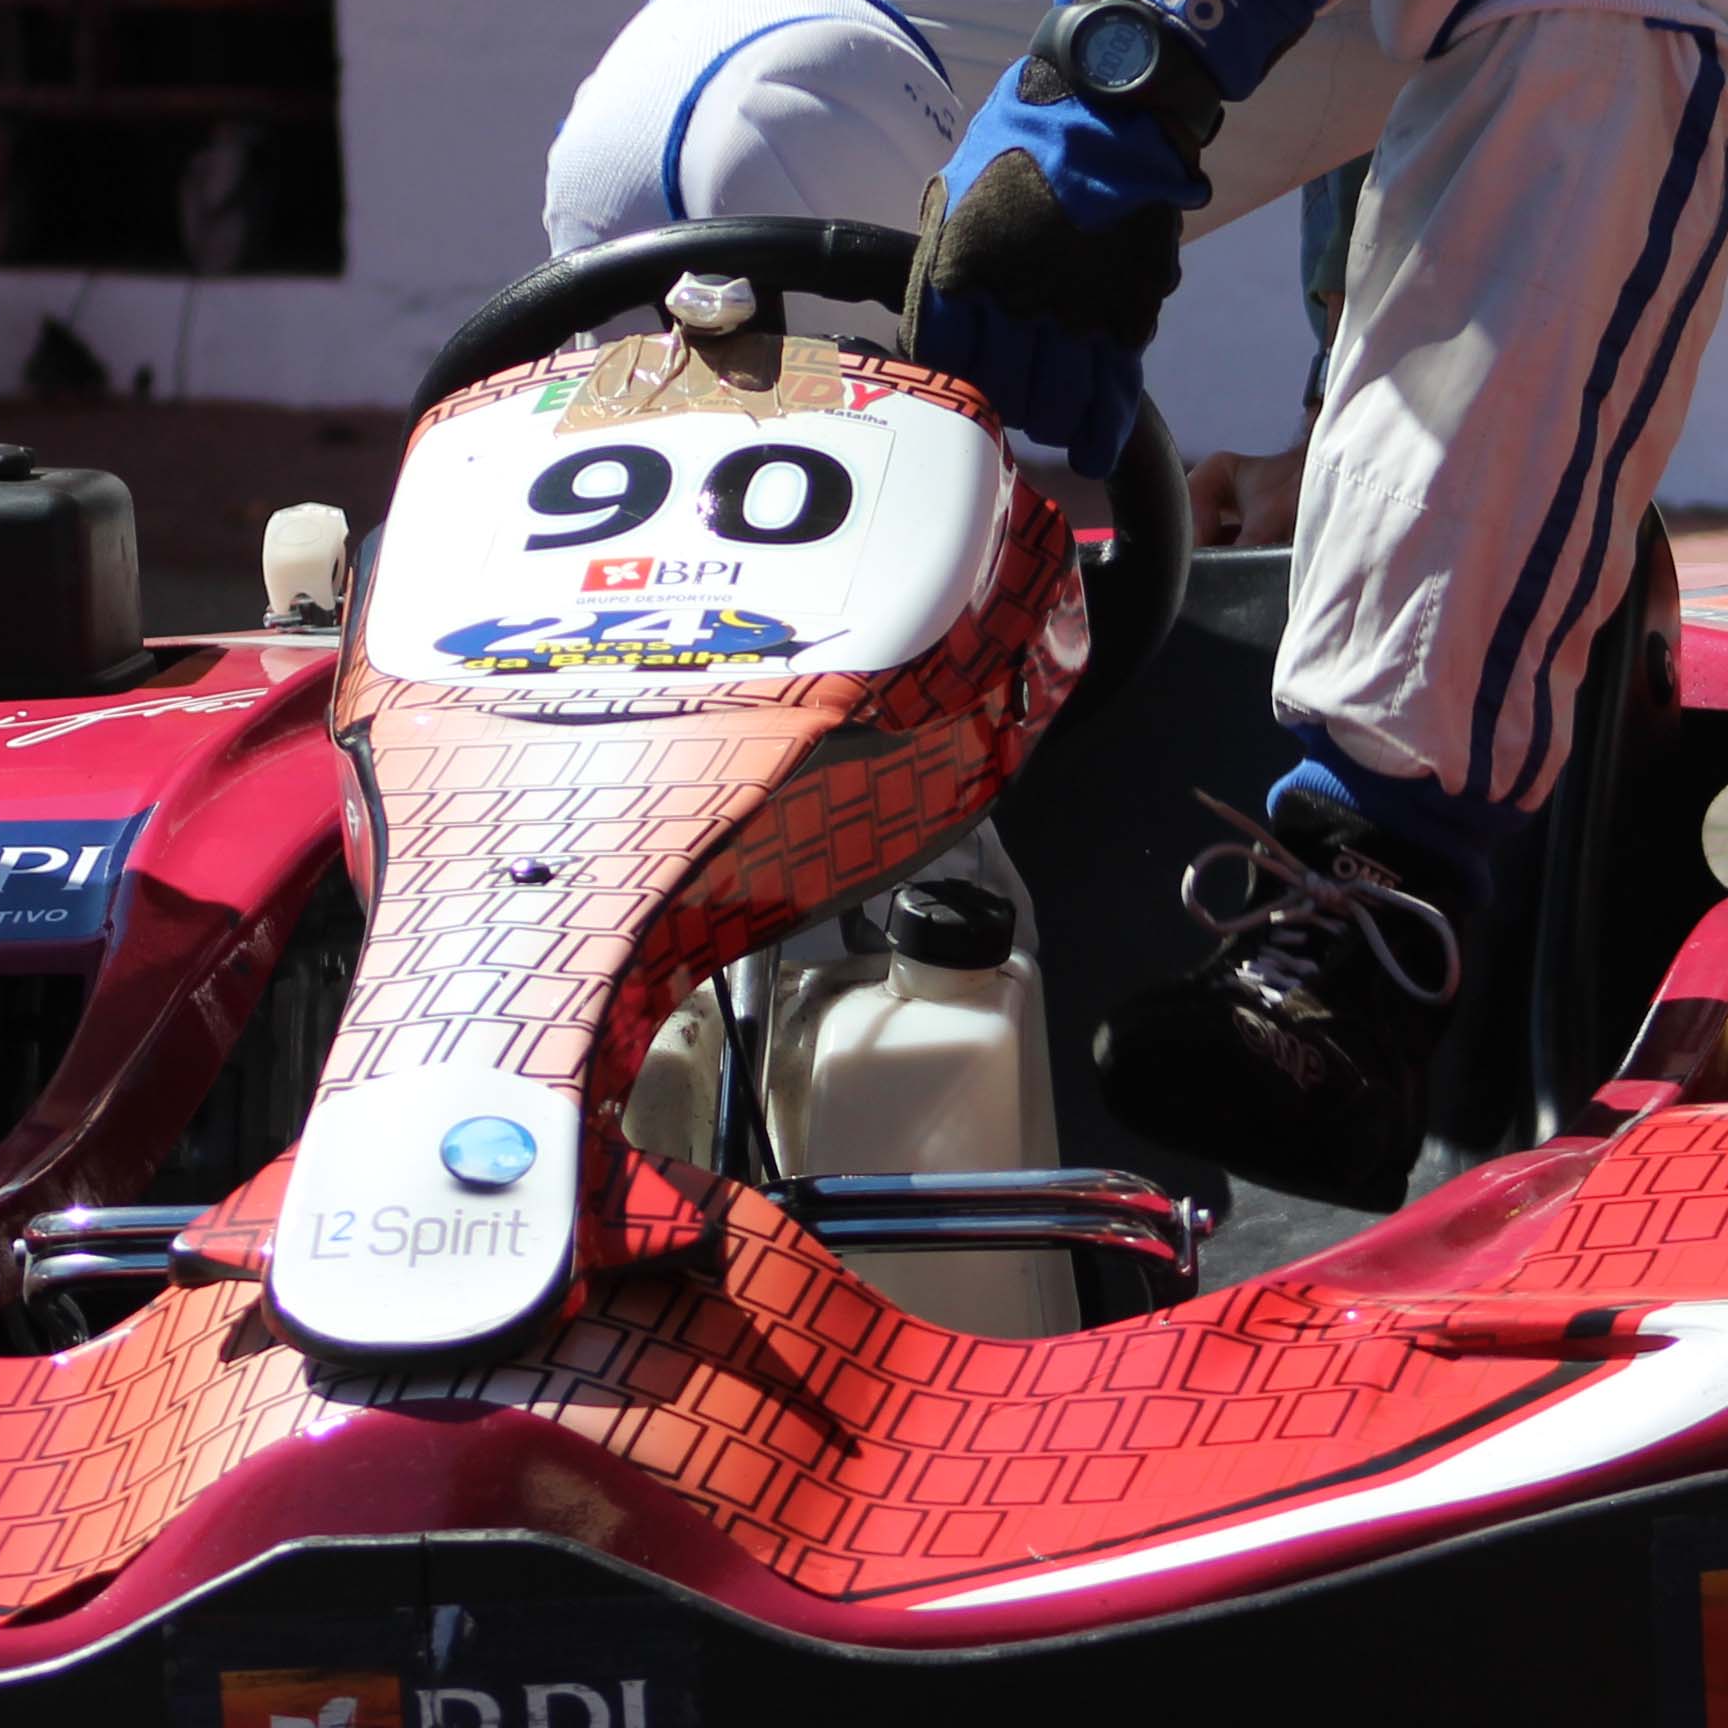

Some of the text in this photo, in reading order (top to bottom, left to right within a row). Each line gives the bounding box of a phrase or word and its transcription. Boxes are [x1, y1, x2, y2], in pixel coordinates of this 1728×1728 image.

[524, 443, 853, 552] 90
[652, 560, 743, 587] BPI
[576, 592, 732, 605] GRUPO DESPORTIVO
[483, 609, 720, 652] 24
[535, 636, 671, 653] horas
[465, 650, 762, 671] da Batalha
[369, 1205, 531, 1267] Spirit
